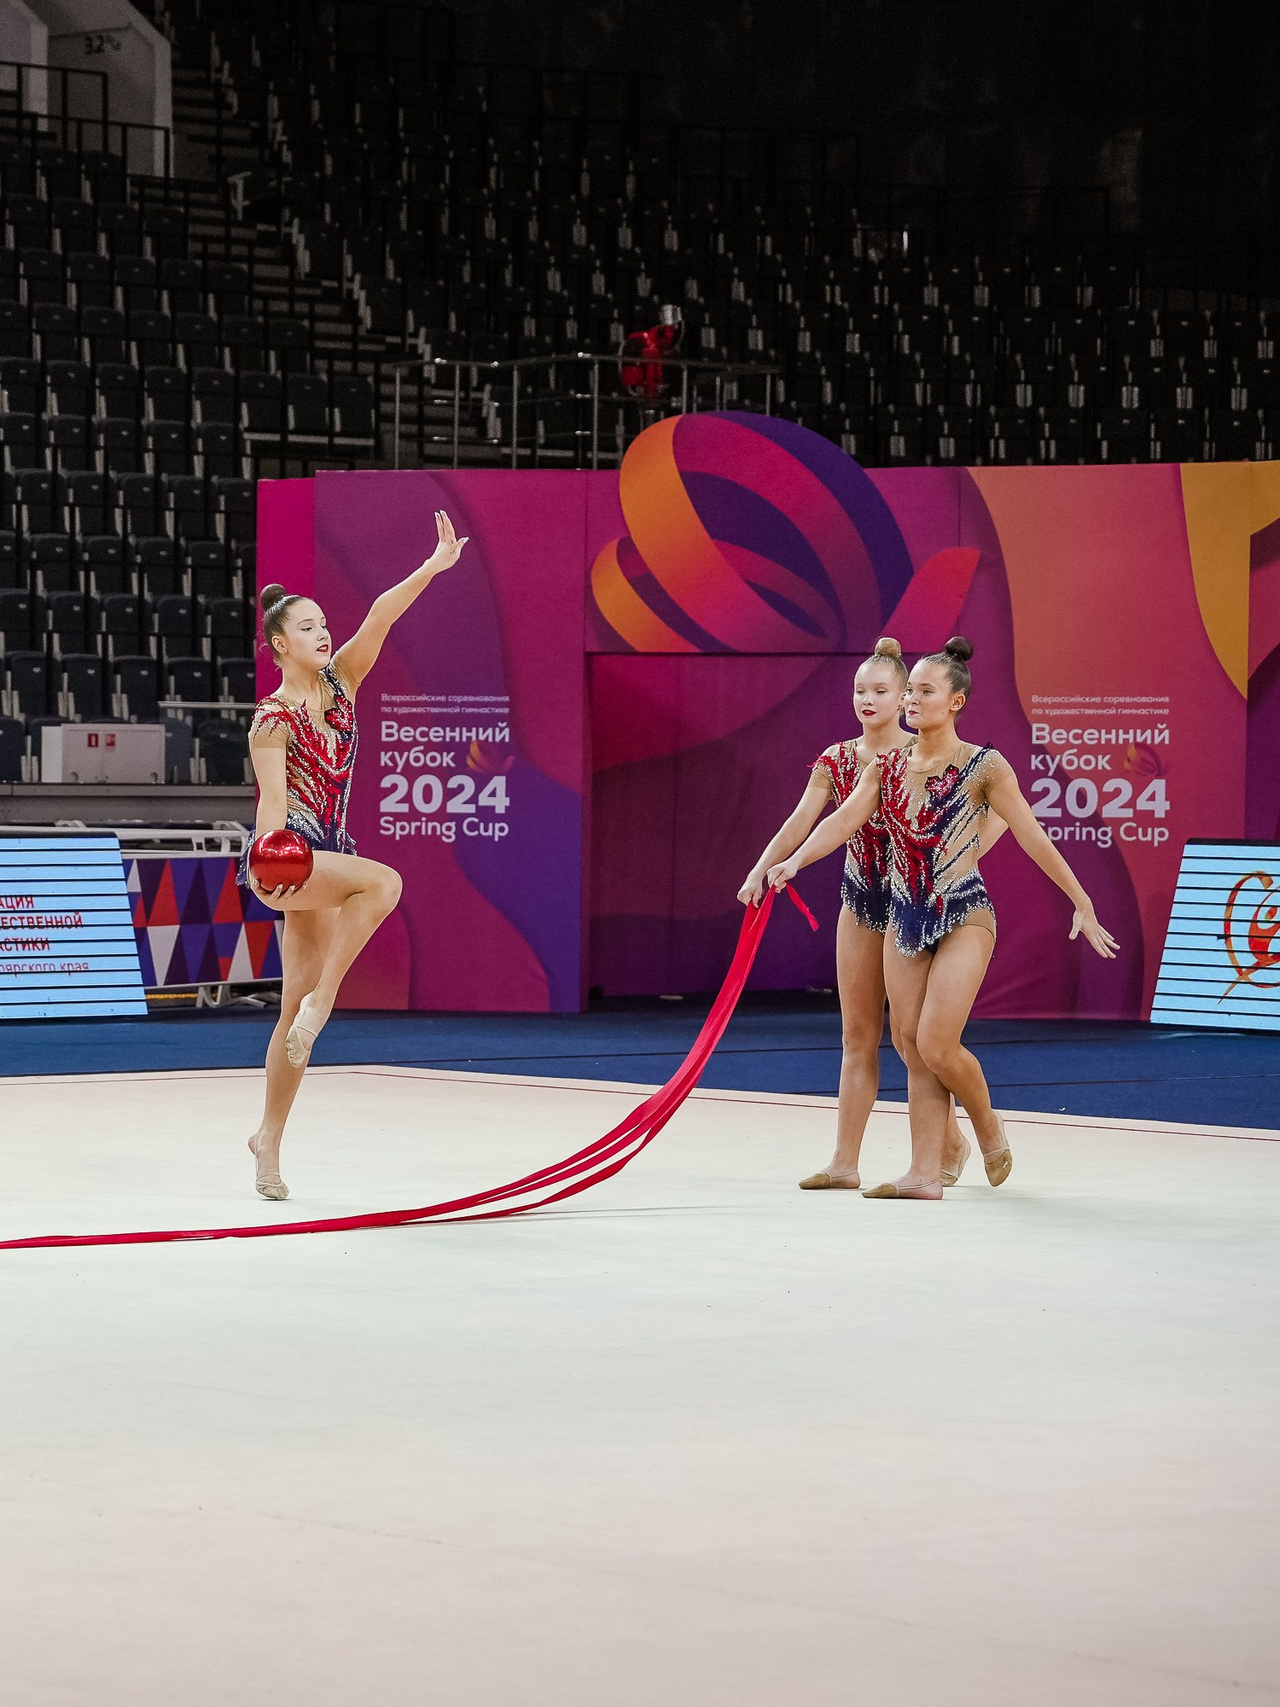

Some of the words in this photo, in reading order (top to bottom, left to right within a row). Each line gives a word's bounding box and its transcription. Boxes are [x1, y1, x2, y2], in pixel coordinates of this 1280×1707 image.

[381, 721, 510, 742] Весенний
[1031, 723, 1170, 745] Весенний
[380, 746, 456, 773] кубок
[1030, 748, 1112, 776] кубок
[379, 774, 510, 814] 2024
[1030, 777, 1170, 818] 2024
[379, 816, 456, 843] Spring
[462, 817, 509, 842] Cup
[1120, 822, 1170, 847] Cup
[60, 961, 89, 977] края
